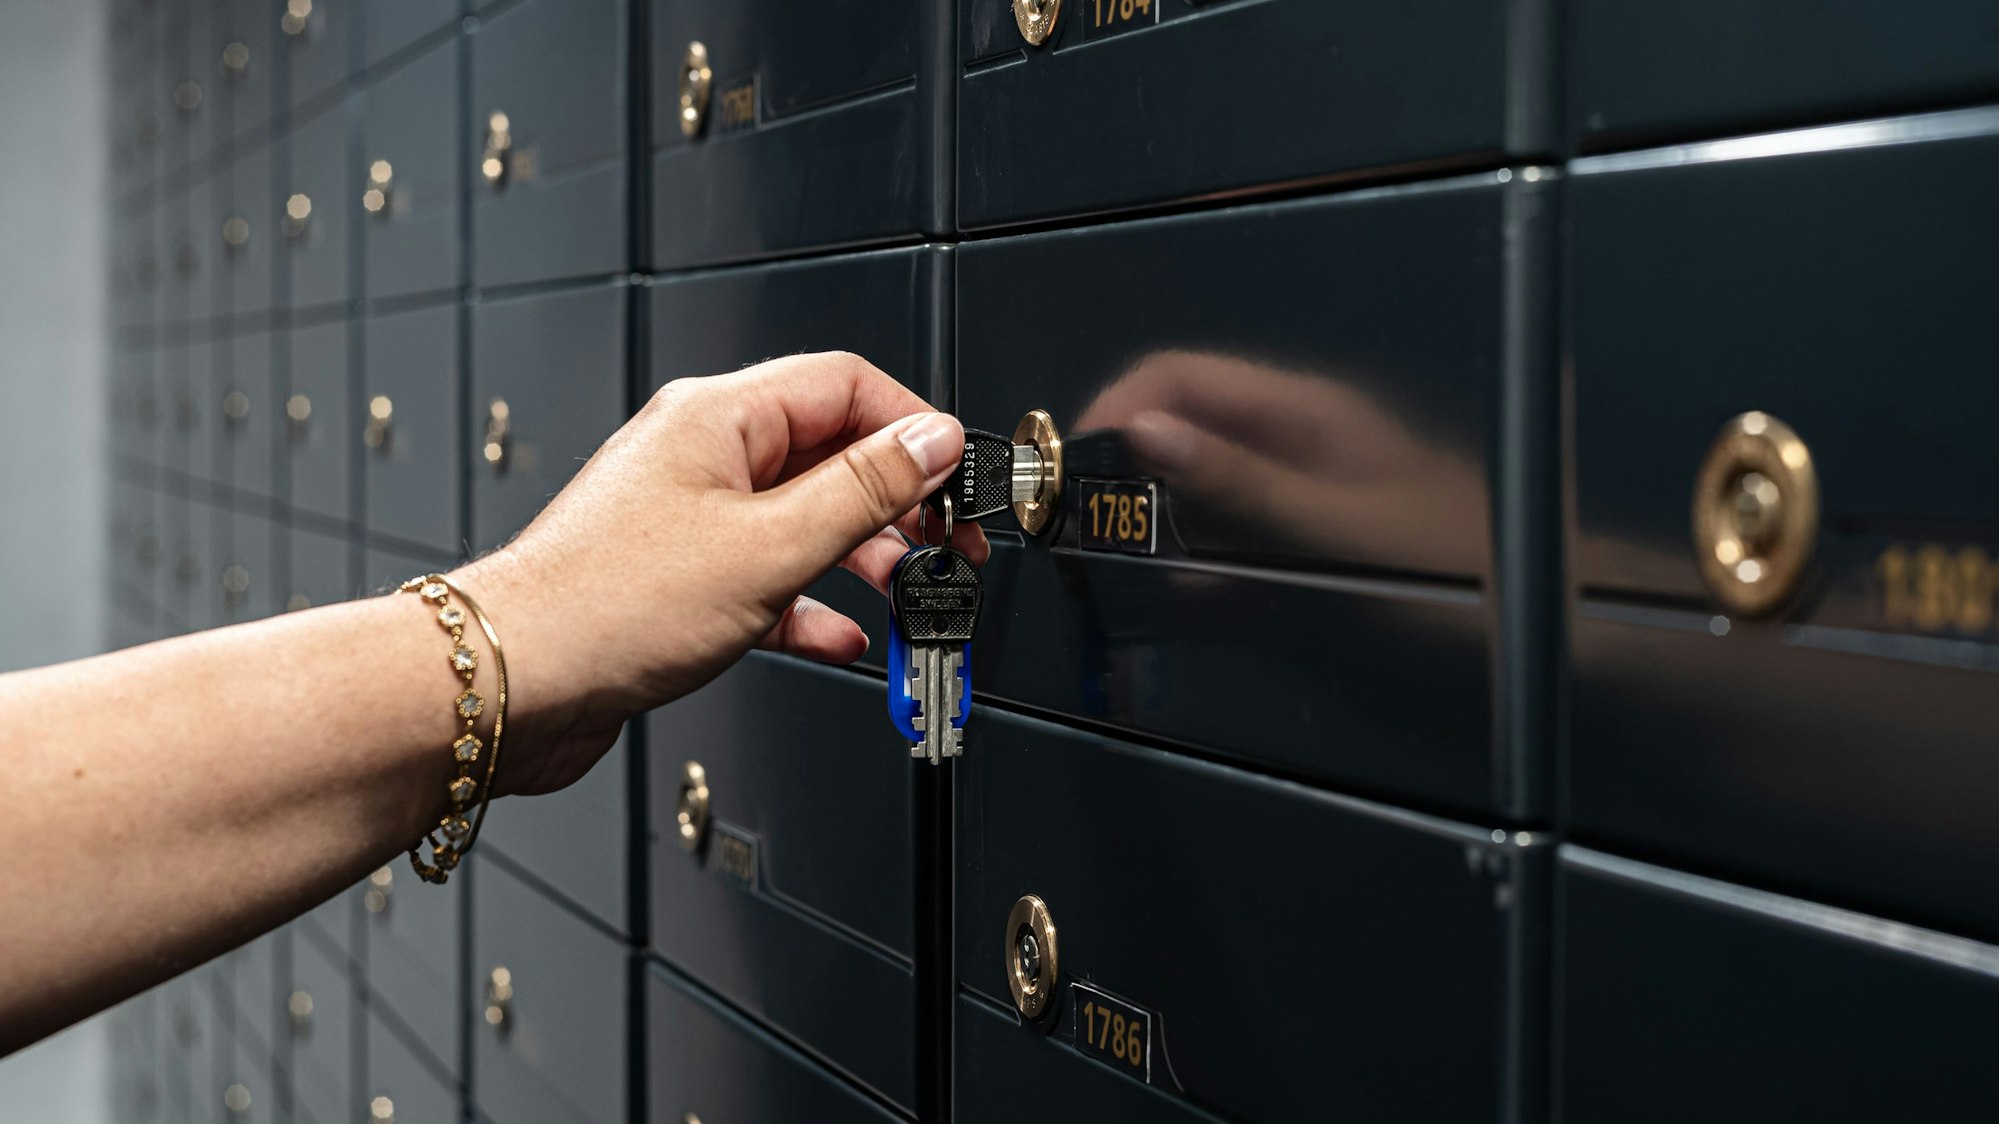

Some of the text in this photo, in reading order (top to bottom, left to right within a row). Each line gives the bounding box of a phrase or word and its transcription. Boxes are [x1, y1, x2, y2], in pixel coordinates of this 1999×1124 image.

[963, 442, 976, 503] 1965329
[1088, 492, 1148, 541] 1785
[920, 598, 962, 608] SWEDEN
[1083, 1001, 1142, 1067] 1786
